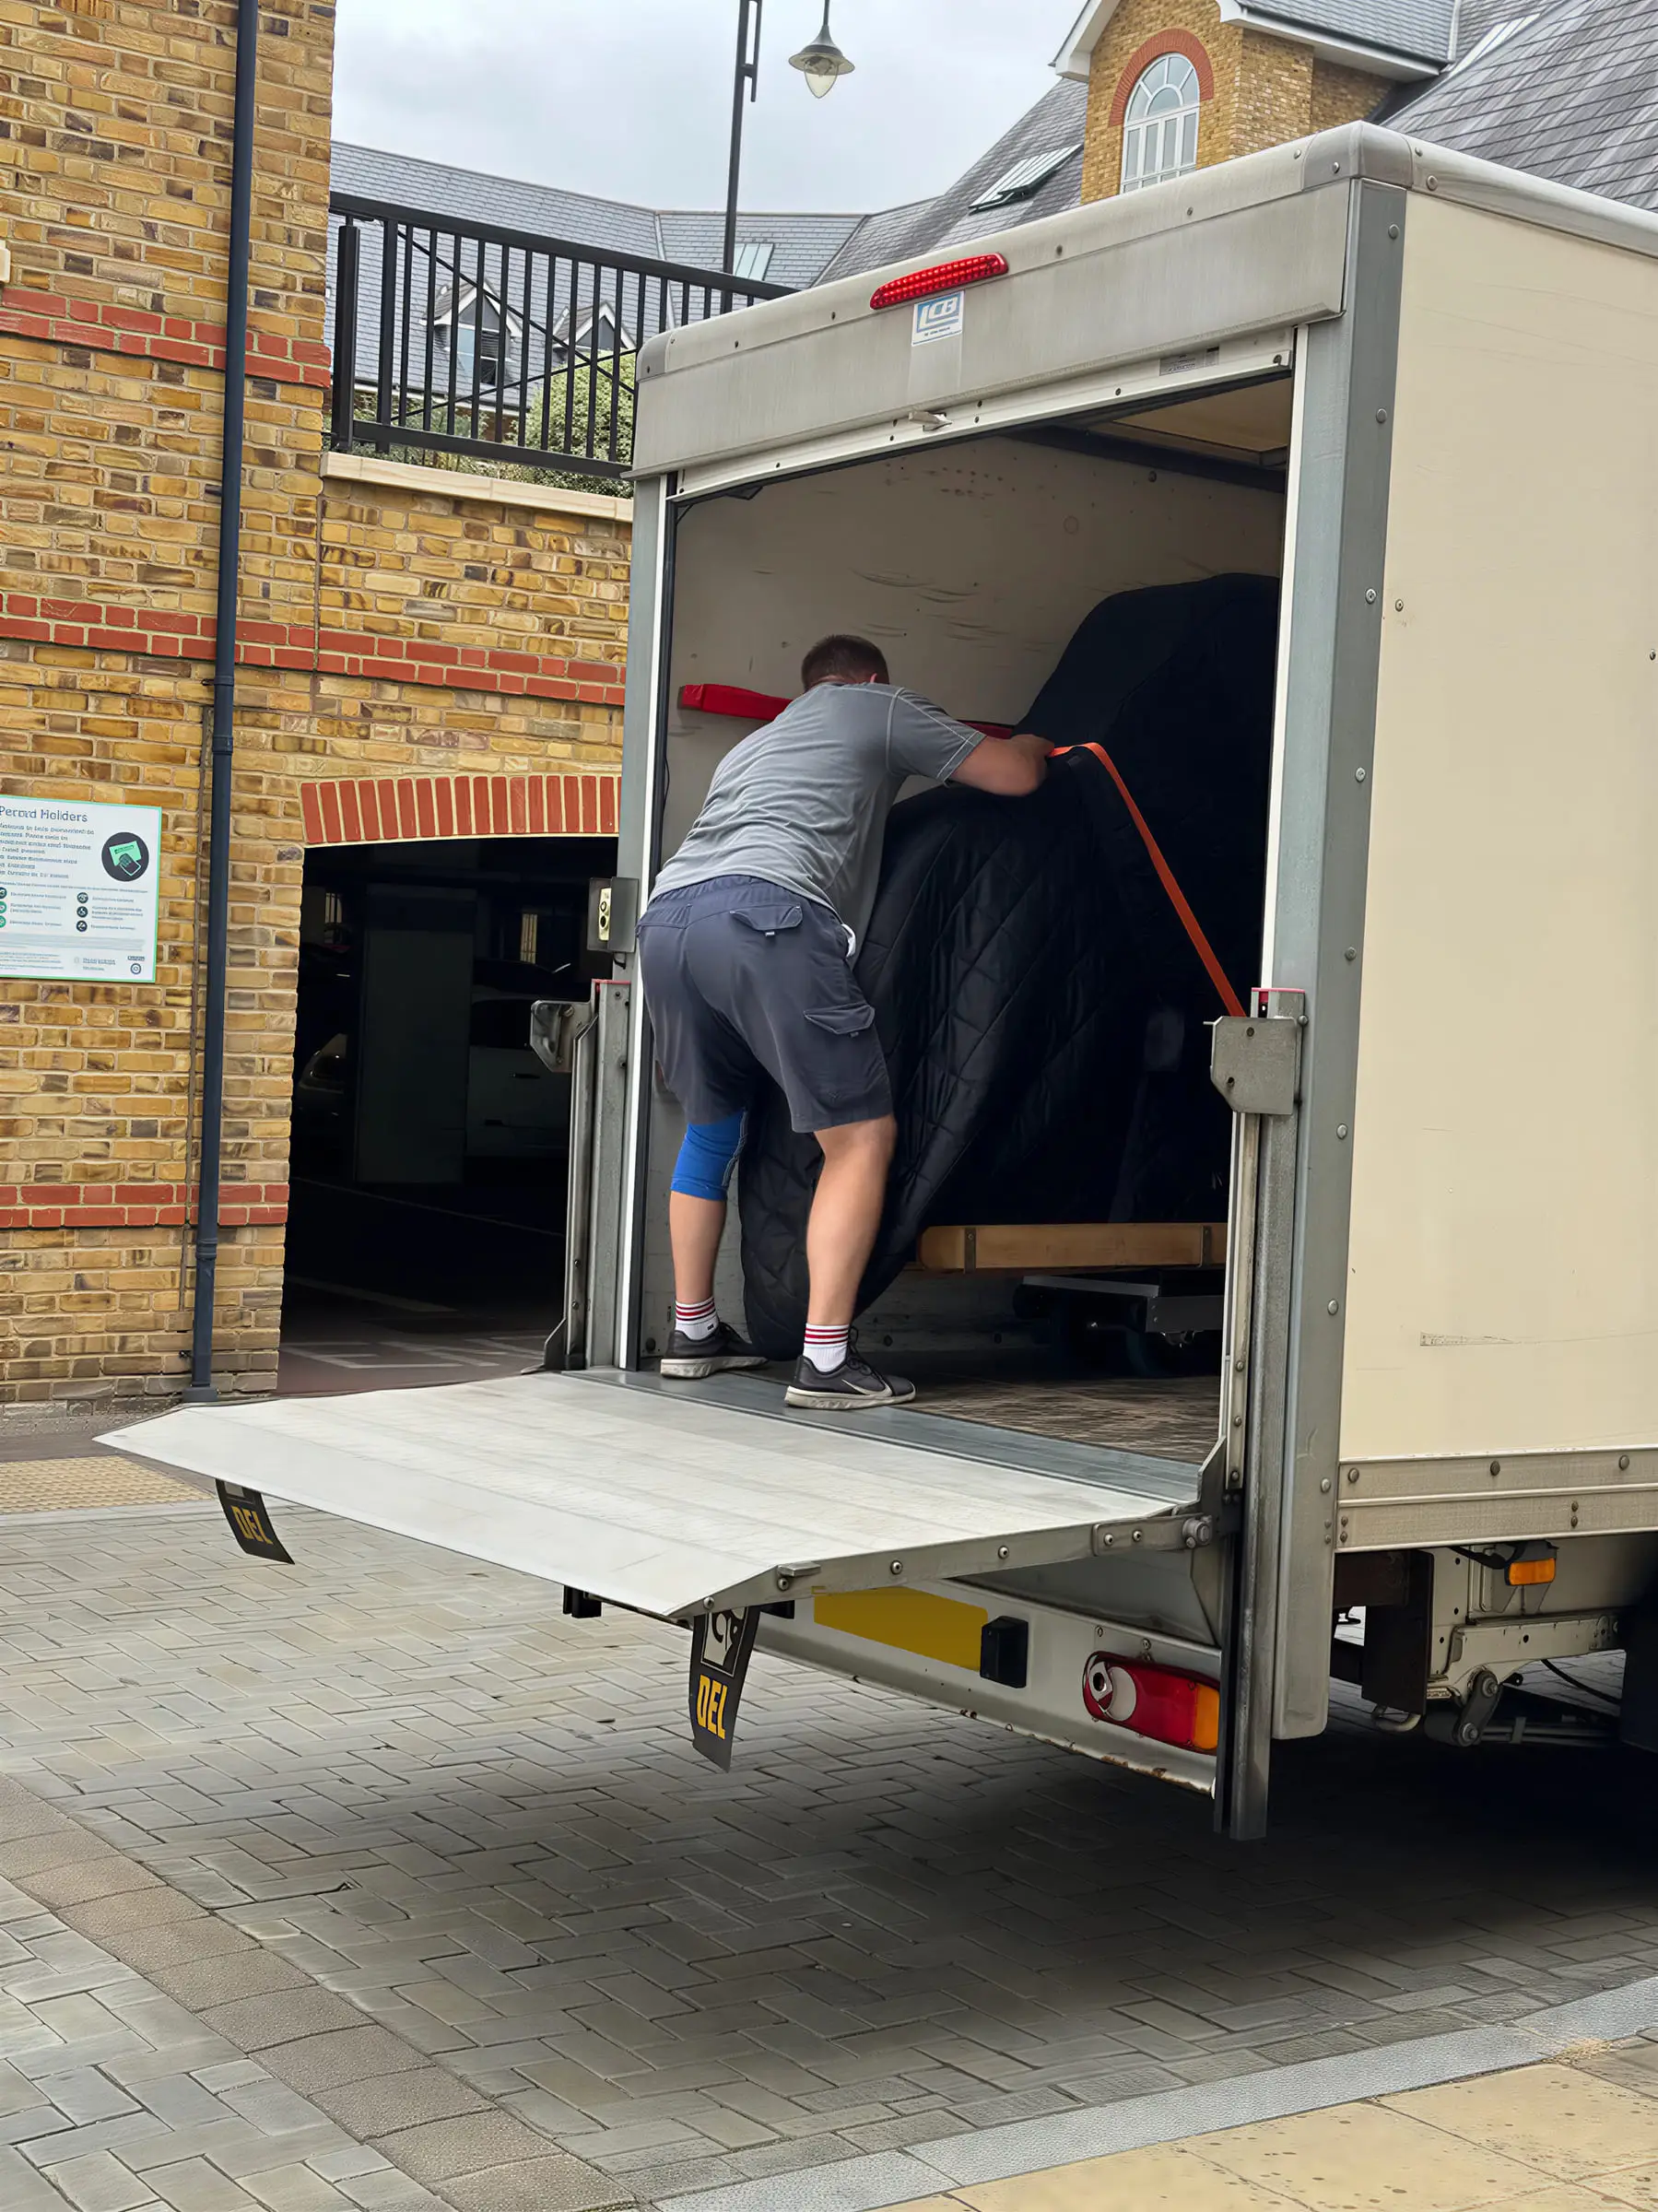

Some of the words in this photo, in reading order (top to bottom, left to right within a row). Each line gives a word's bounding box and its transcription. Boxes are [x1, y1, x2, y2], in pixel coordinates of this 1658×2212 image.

[41, 809, 88, 822] Holders
[230, 1505, 274, 1545] DEL
[696, 1674, 728, 1740] DEL
